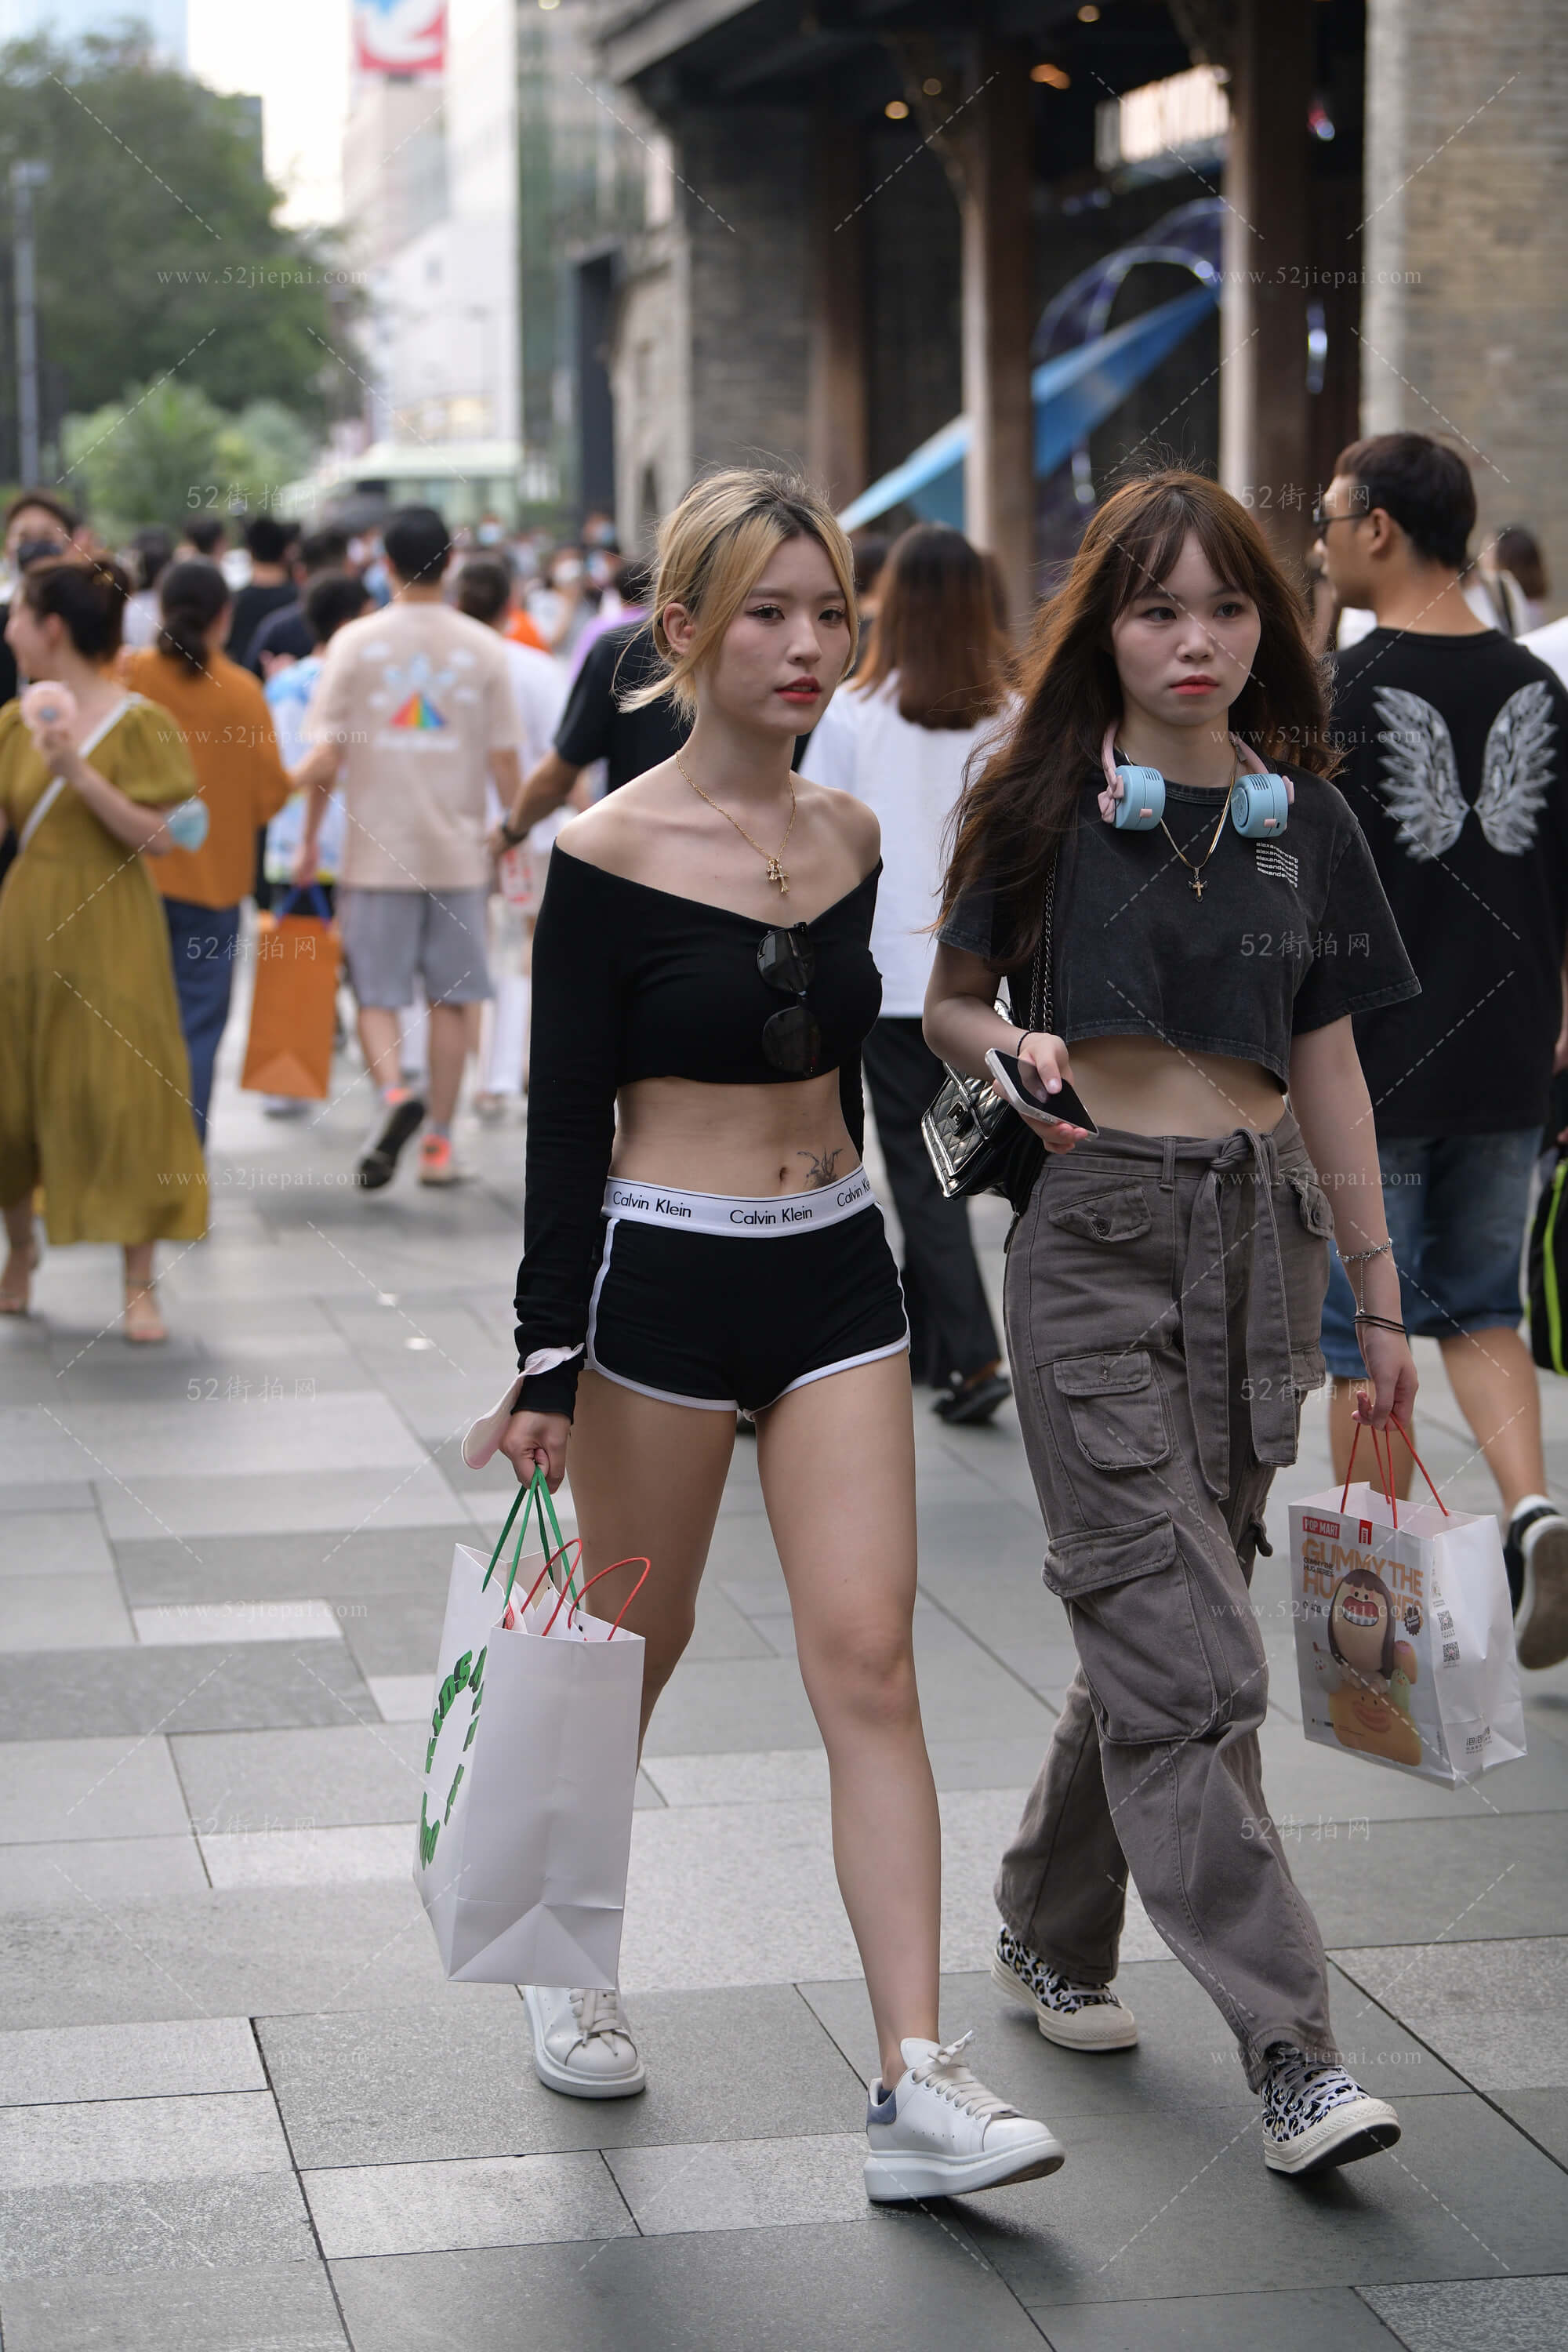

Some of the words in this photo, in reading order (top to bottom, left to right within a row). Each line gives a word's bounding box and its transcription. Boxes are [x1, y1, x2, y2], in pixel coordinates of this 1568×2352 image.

[612, 1191, 649, 1210] Calvin
[655, 1197, 692, 1218] Klein
[837, 1185, 862, 1207] Calvin
[862, 1178, 871, 1193] Kle
[730, 1210, 776, 1225] Calvin
[782, 1205, 813, 1224] Klein
[1305, 1517, 1319, 1531] POP
[1319, 1522, 1338, 1537] MART
[1302, 1538, 1387, 1577] GUMMY
[1388, 1560, 1423, 1598] THE
[1303, 1566, 1342, 1600] HU
